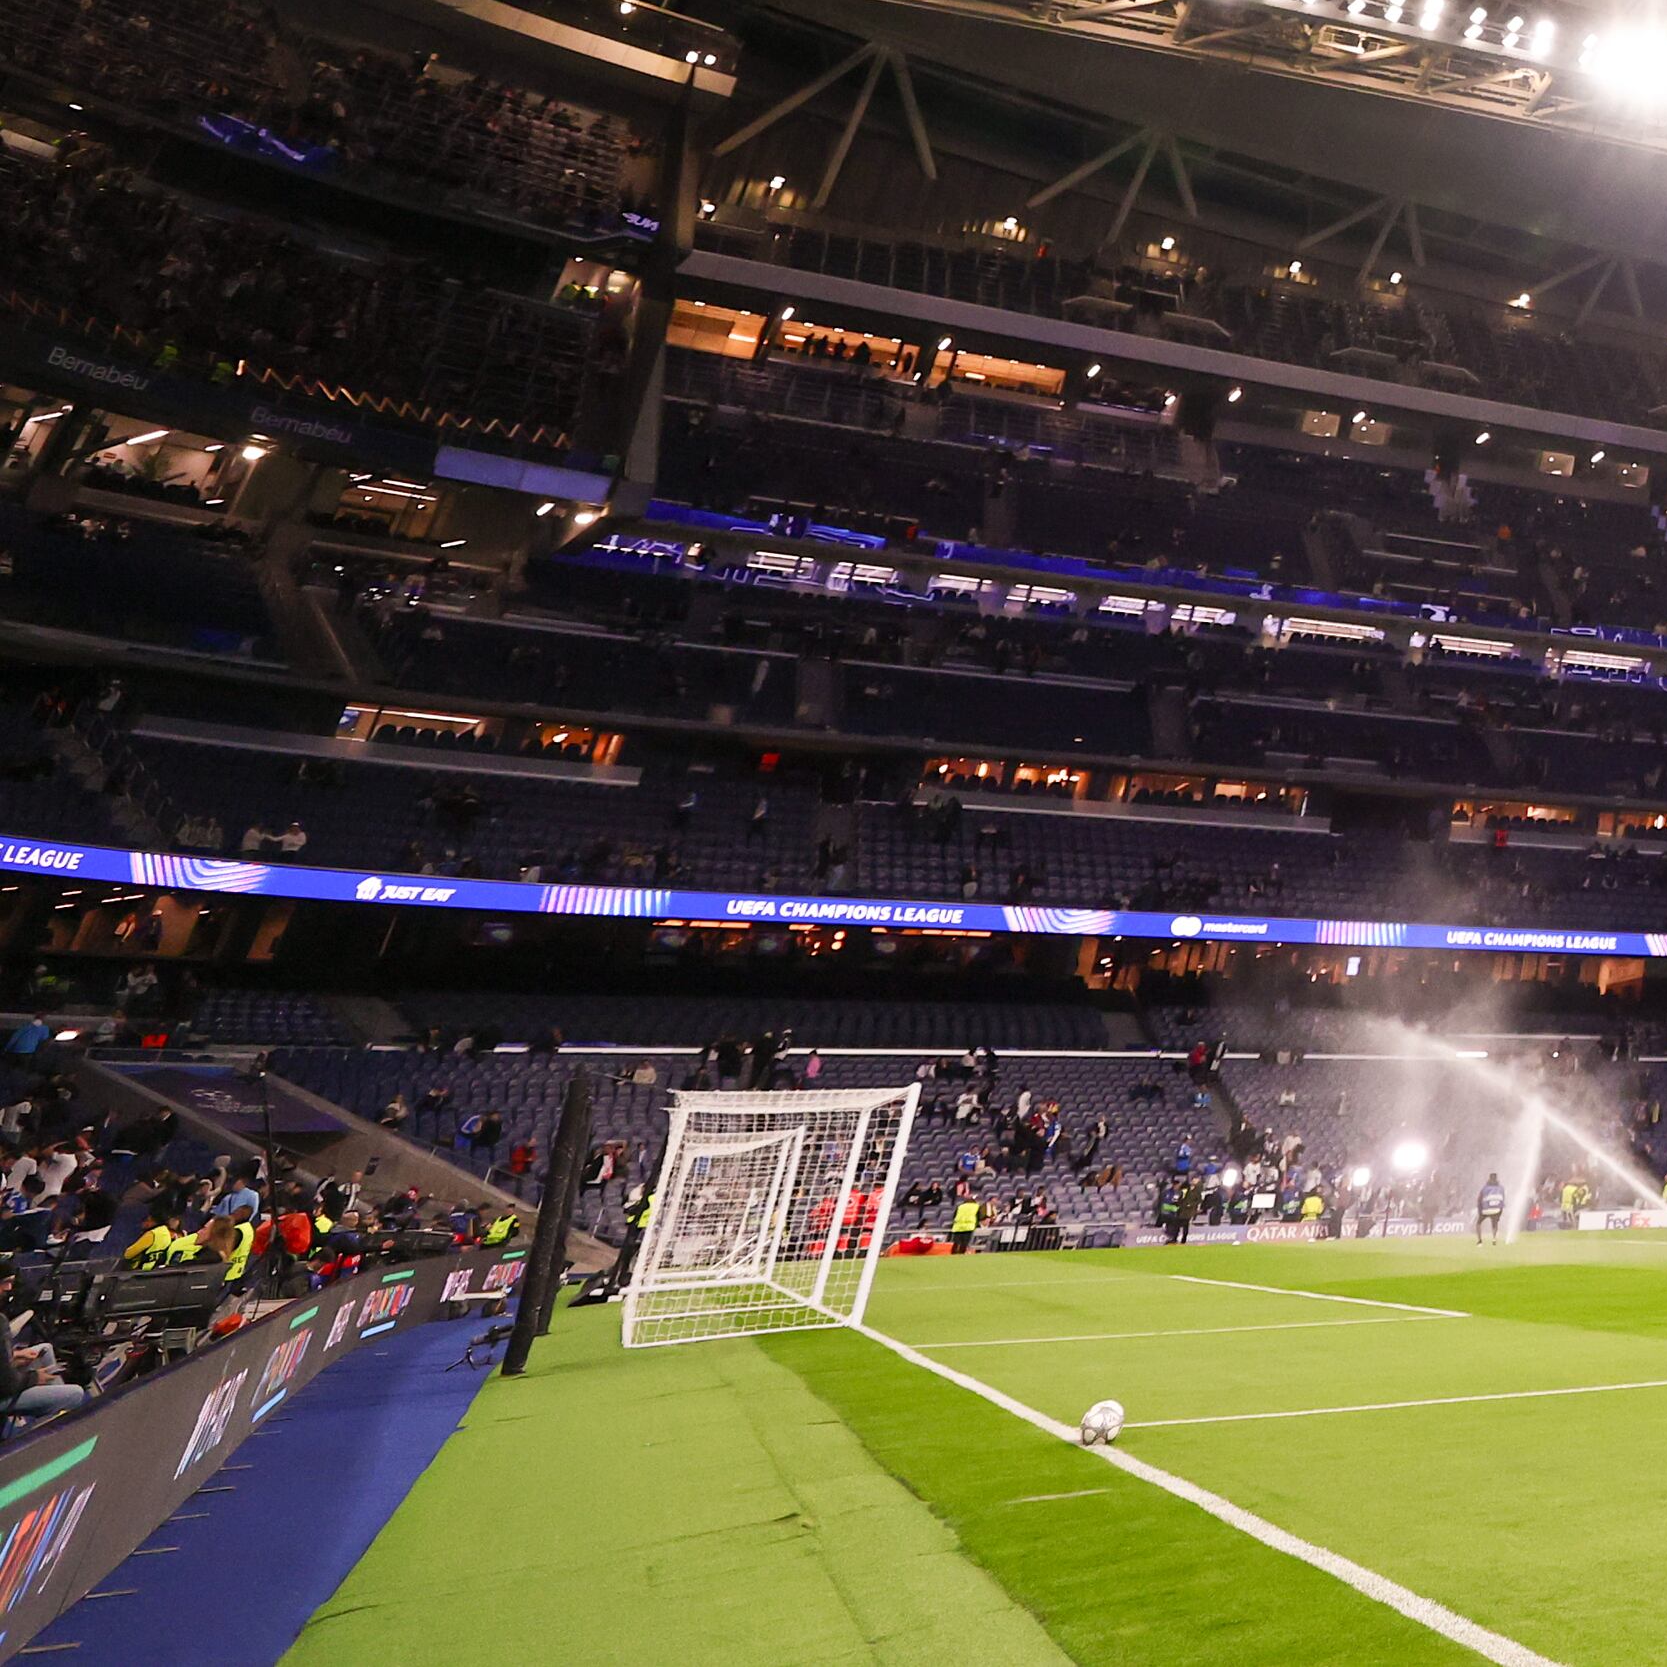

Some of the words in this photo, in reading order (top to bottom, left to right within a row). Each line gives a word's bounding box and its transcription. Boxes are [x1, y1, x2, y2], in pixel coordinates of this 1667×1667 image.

[47, 344, 149, 392] Bernabéu
[3, 845, 84, 871] LEAGUE
[379, 884, 425, 902] JUST
[420, 887, 457, 904] EAT
[727, 900, 777, 917] UEFA
[780, 901, 892, 922] CHAMPIONS
[893, 907, 964, 925] LEAGUE
[1203, 920, 1268, 935] mastercard
[1447, 930, 1483, 946] UEFA
[1484, 932, 1565, 949] CHAMPIONS
[1565, 934, 1617, 951] LEAGUE
[1606, 1212, 1651, 1230] FedEx
[1246, 1226, 1297, 1241] QATAR
